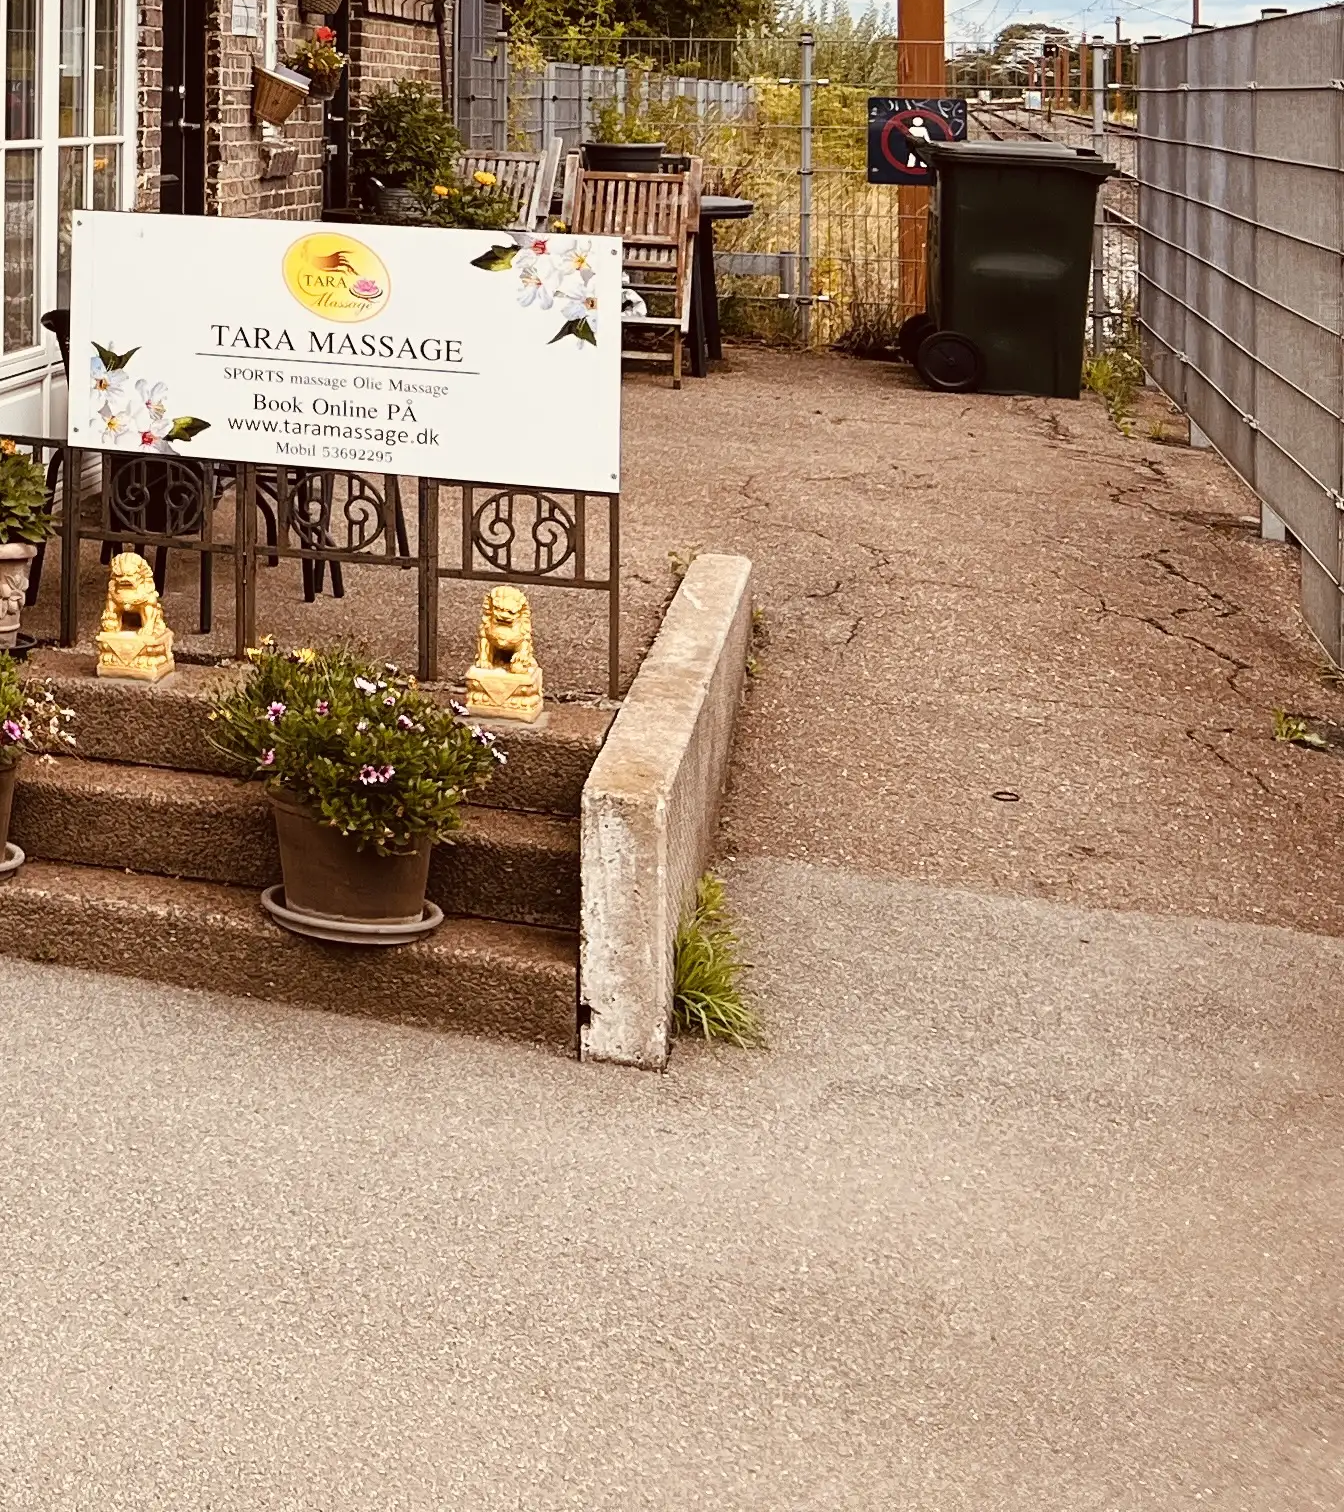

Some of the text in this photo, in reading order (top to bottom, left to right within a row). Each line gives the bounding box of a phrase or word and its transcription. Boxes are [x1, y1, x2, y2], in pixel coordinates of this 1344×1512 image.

[304, 274, 348, 289] TARA
[210, 324, 464, 364] TARA MASSAGE
[223, 367, 449, 399] SPORTS massage Olie Massage
[253, 393, 418, 423] Book Online PÅ
[227, 417, 440, 447] www.taramassage.dk
[275, 441, 394, 464] Mobil 53692295
